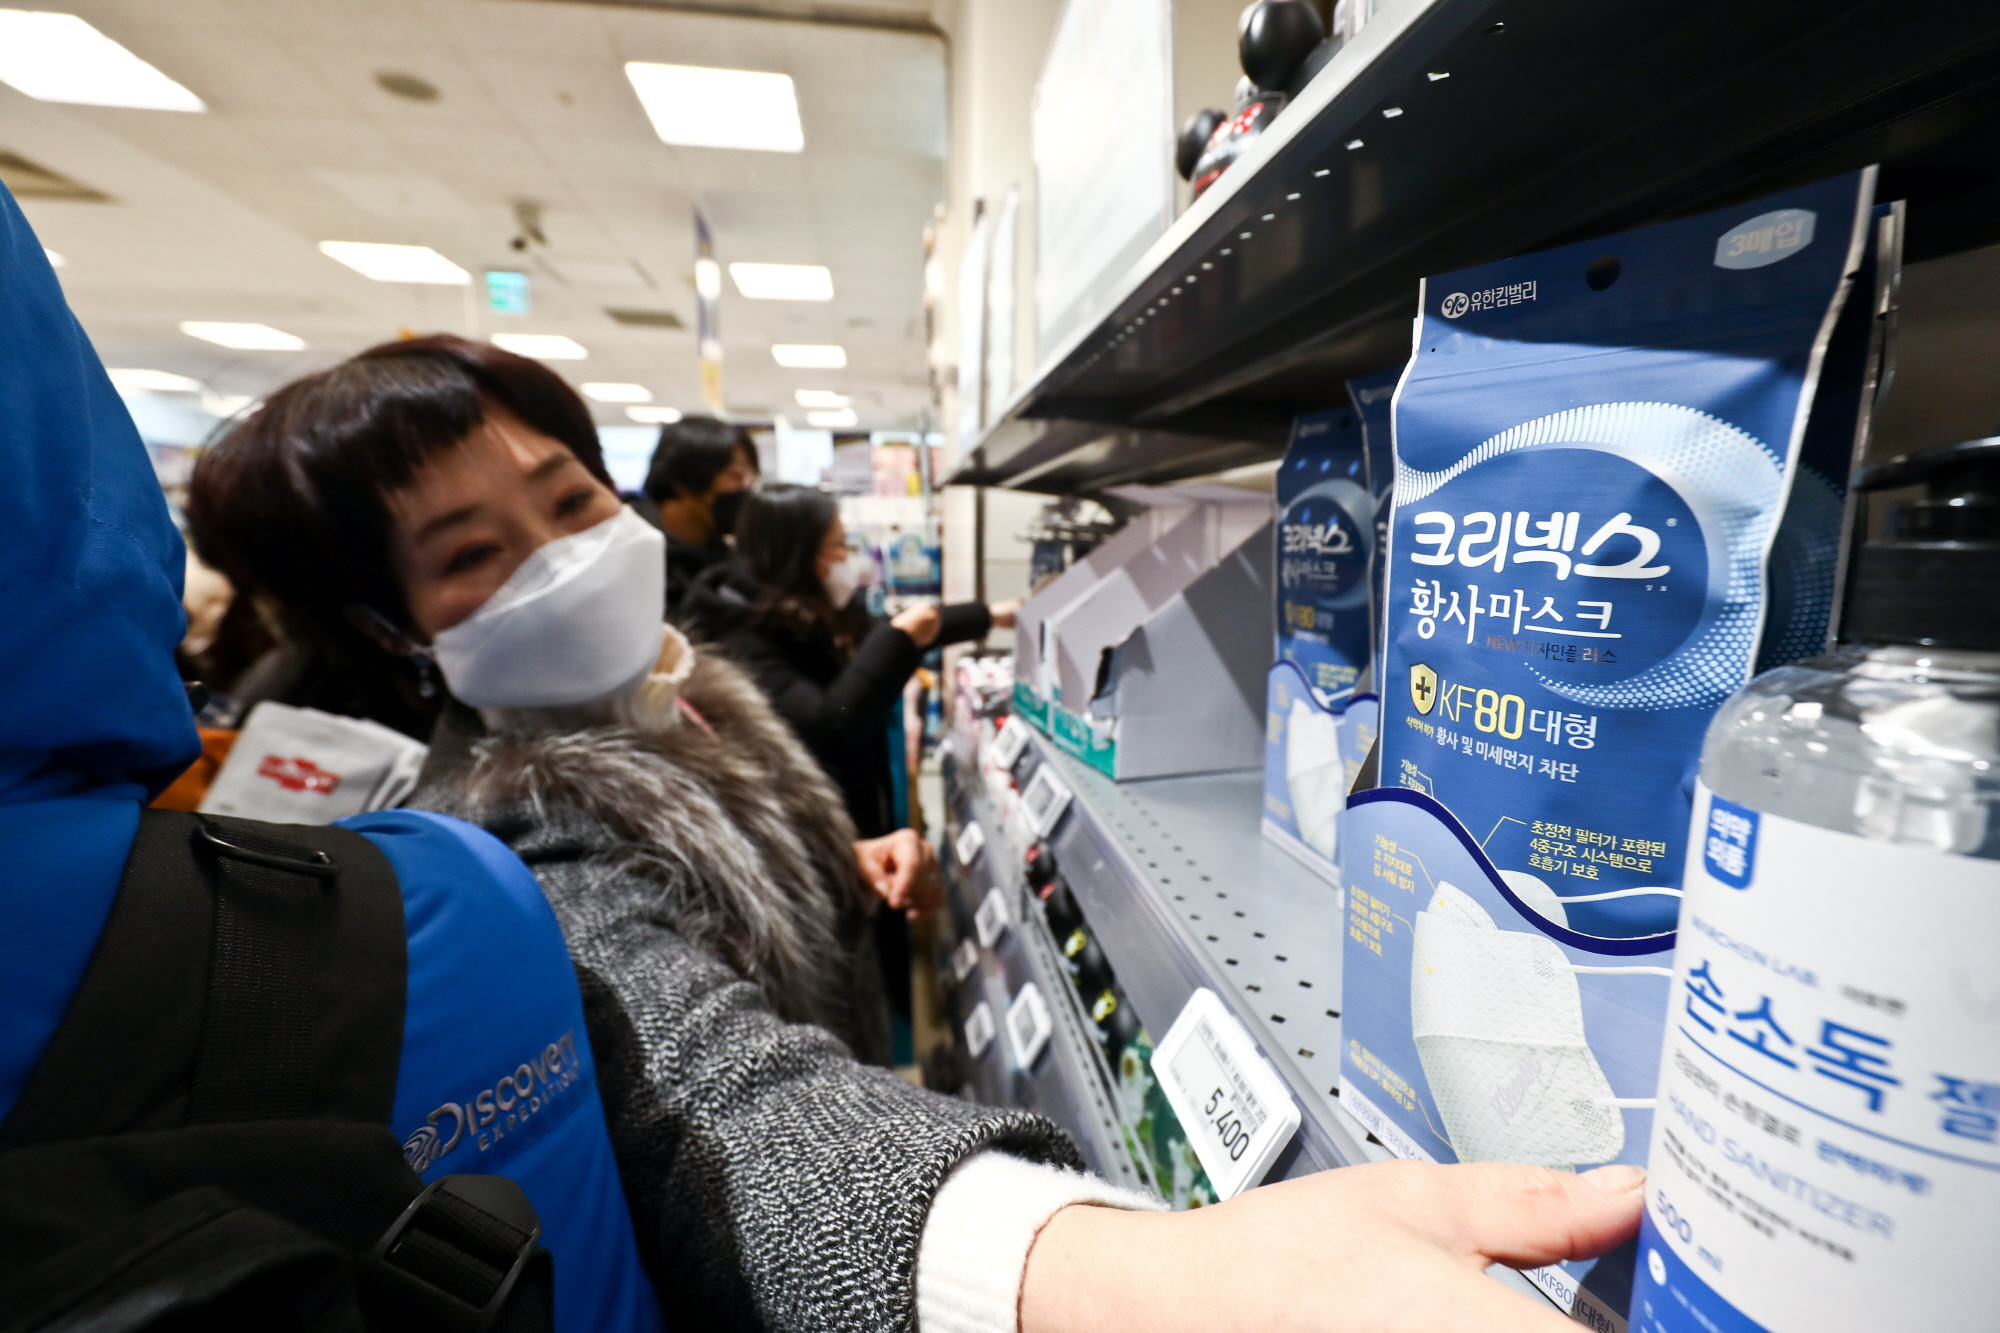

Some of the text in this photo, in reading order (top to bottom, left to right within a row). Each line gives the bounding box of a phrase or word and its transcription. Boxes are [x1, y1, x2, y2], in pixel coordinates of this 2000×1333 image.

[1728, 219, 1804, 256] 3매입
[1470, 280, 1537, 312] 유한킴벌리
[1411, 511, 1671, 580] 크리넥스
[1409, 578, 1622, 644] 황사마스크
[1487, 635, 1520, 652] NEW
[1439, 680, 1598, 750] KF80 대형
[1401, 759, 1418, 777] 기능성
[1436, 727, 1580, 783] 황사 및 미세먼지 차단
[1400, 773, 1407, 785] 코
[1529, 837, 1653, 873] 4중구조 시스템으로
[1531, 820, 1666, 858] 초정전 필터가 포함된
[1528, 853, 1600, 881] 호흡기 보호
[1684, 958, 1903, 1113] 손소독
[1668, 1089, 1717, 1146] HAND
[1722, 1137, 1896, 1240] SANITIZER
[1657, 1189, 1693, 1244] 500
